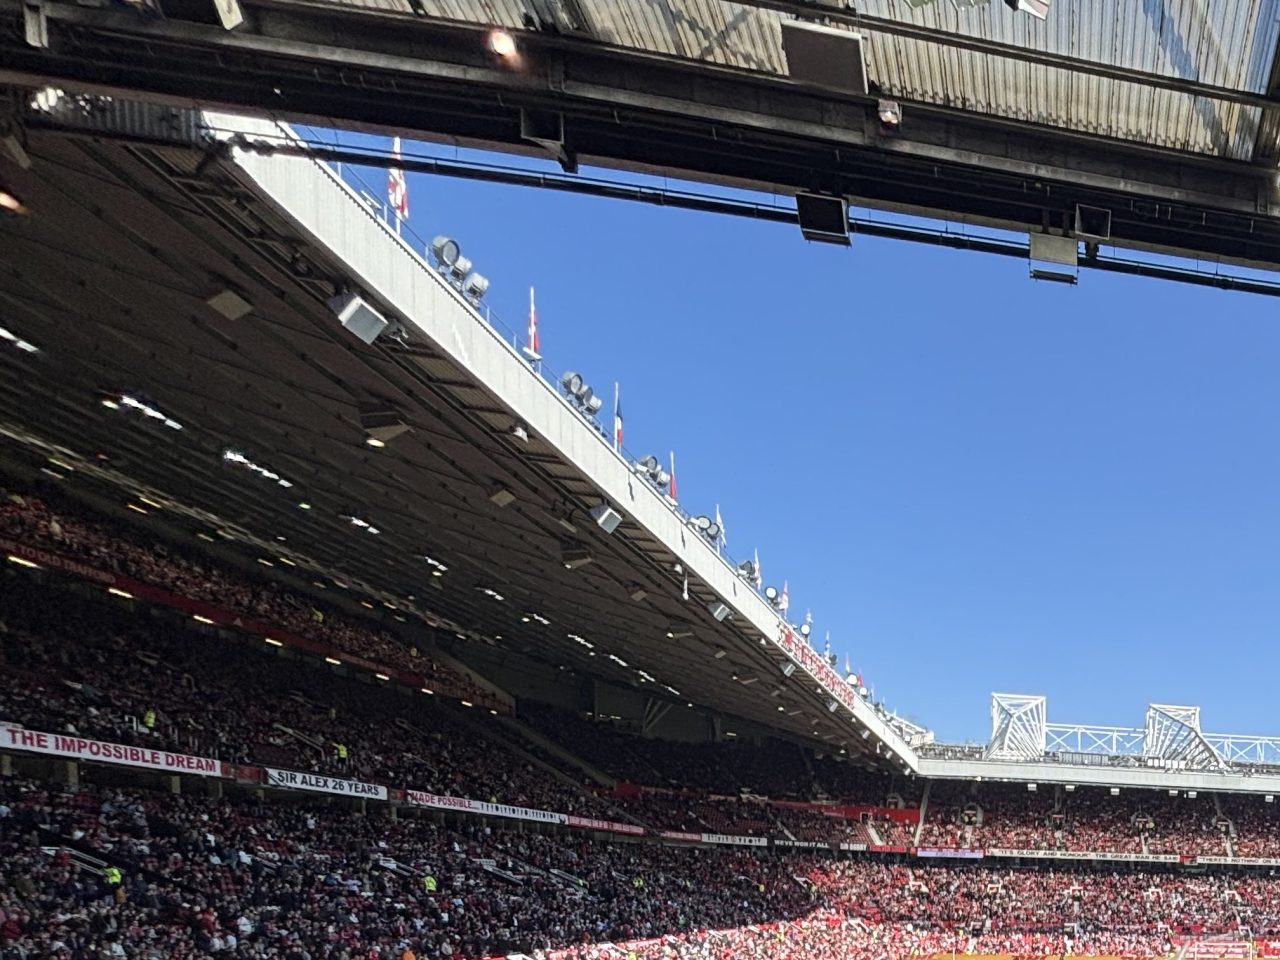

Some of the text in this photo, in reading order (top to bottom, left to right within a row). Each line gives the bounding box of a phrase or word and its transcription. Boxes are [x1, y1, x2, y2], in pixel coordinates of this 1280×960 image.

[7, 729, 217, 773] THE IMPOSSIBLE DREAM
[277, 771, 380, 797] SIR ALEX 26 YEARS
